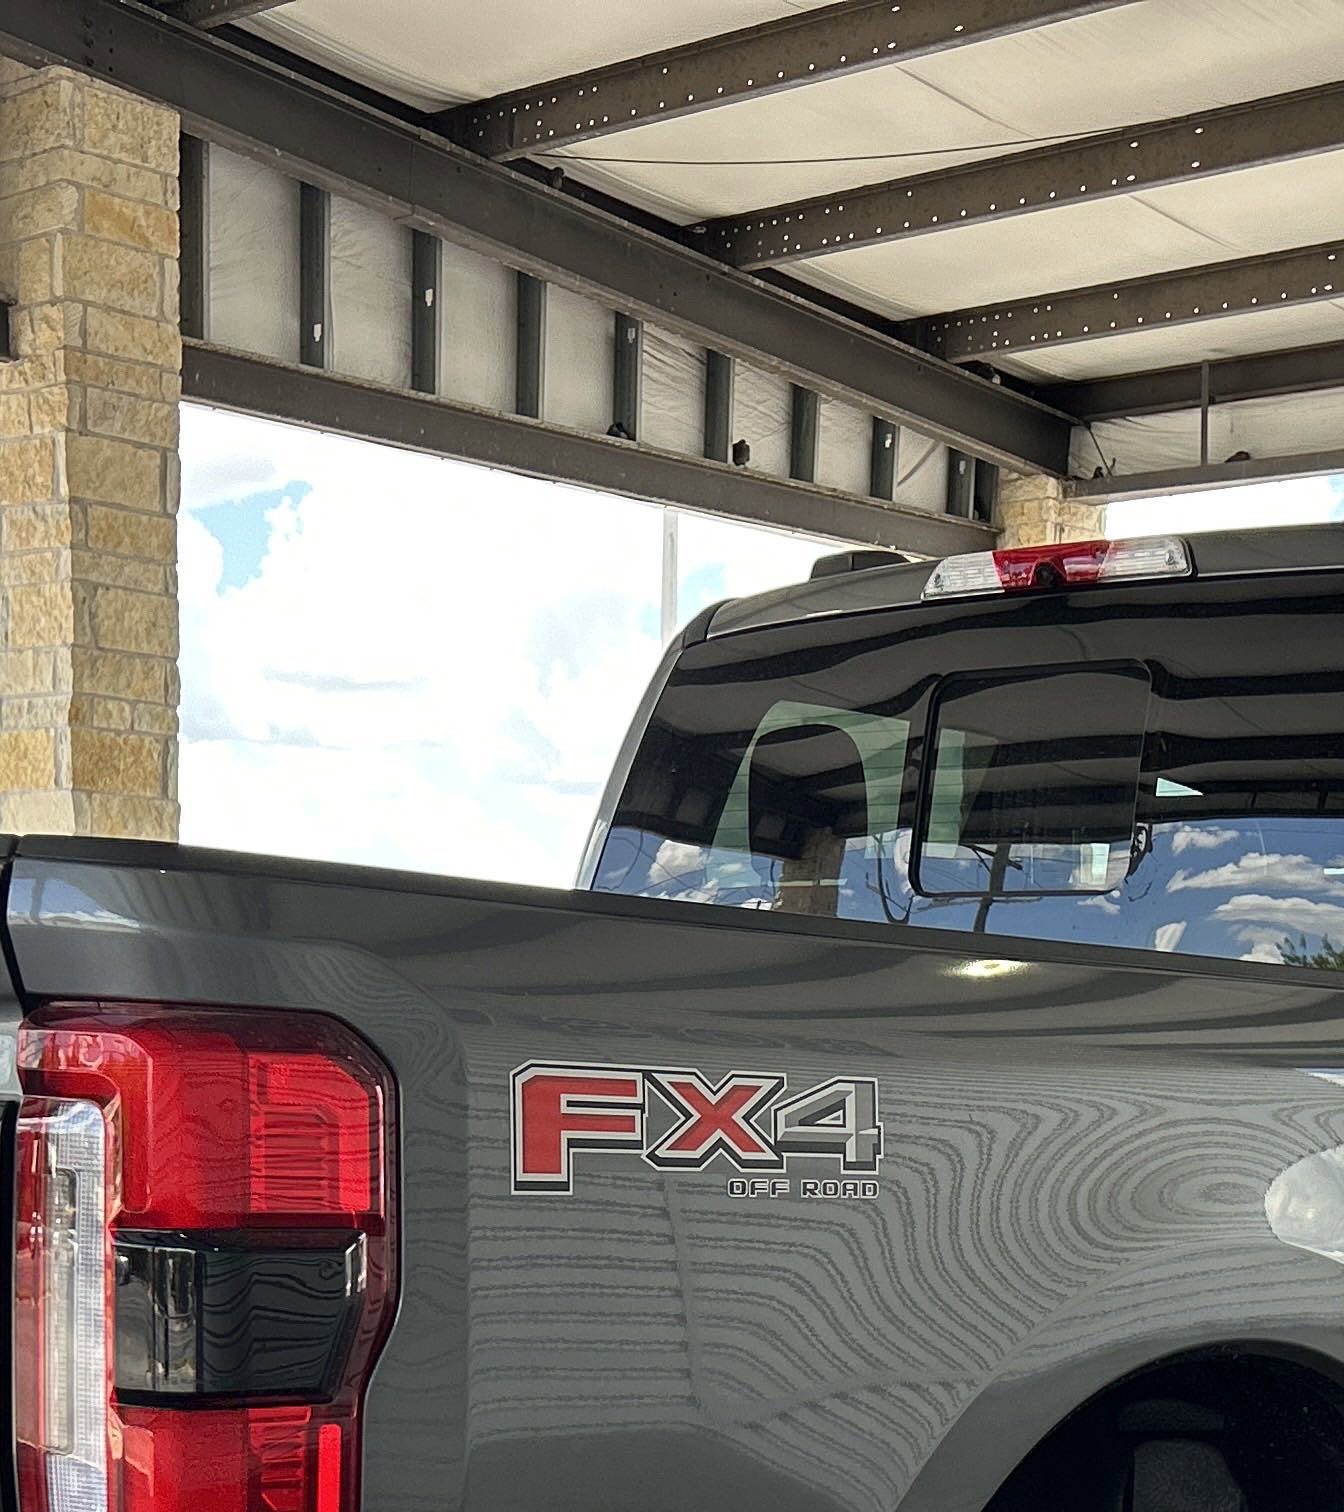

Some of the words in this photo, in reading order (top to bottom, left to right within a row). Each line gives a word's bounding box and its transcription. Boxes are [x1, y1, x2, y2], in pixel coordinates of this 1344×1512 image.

[509, 1059, 884, 1195] FX4
[727, 1178, 790, 1198] OFF
[800, 1178, 879, 1198] ROAD
